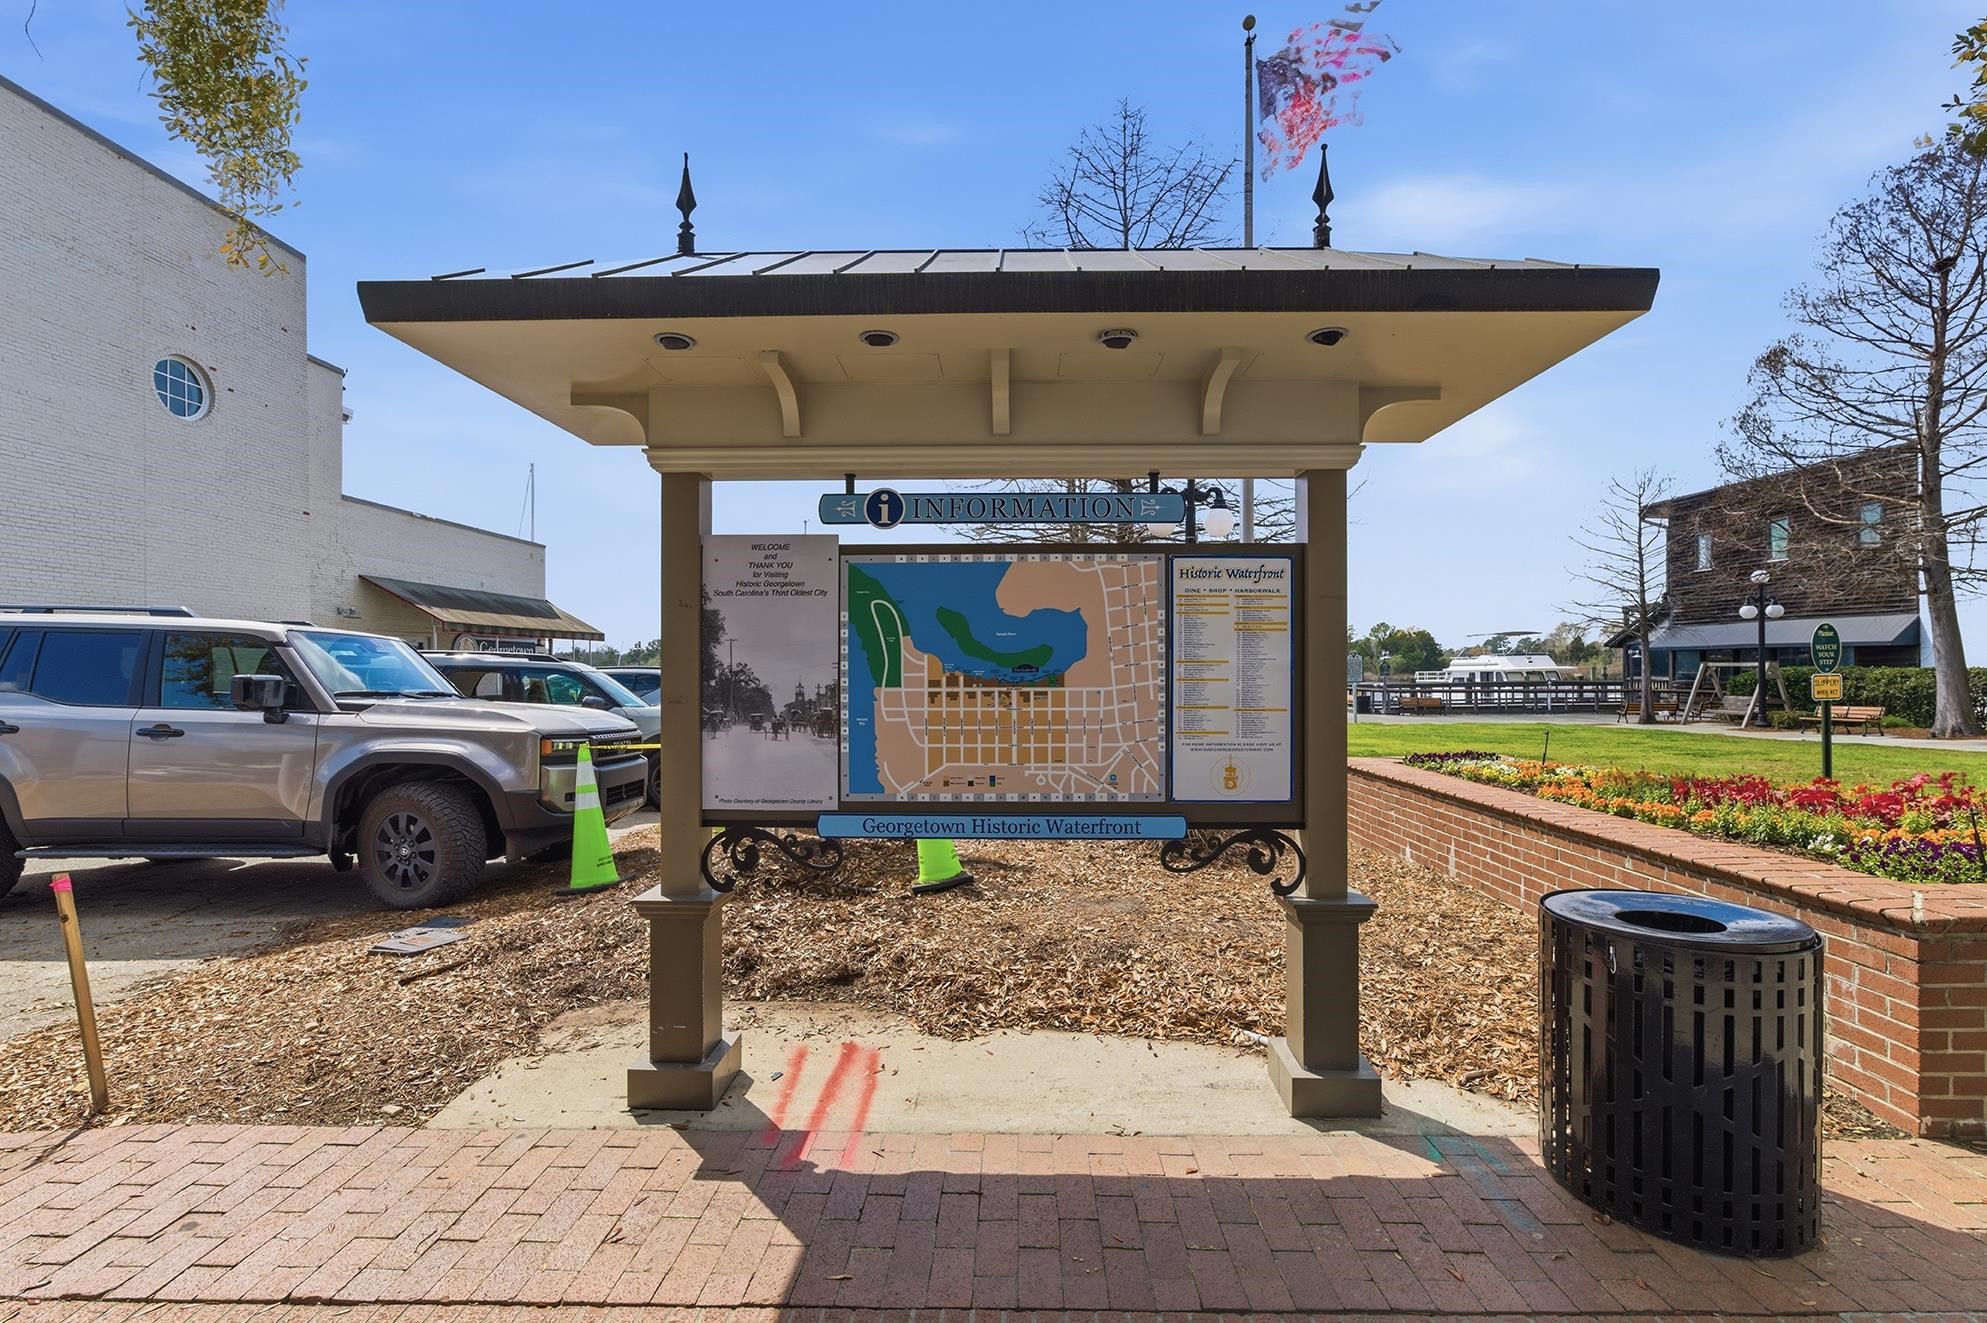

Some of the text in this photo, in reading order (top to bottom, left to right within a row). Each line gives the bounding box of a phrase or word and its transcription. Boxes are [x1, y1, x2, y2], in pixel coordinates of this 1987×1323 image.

[911, 496, 1136, 519] INFORMATION
[751, 543, 791, 551] WELCOME
[764, 571, 789, 579] Visiting
[1180, 564, 1285, 583] Historic Waterfront
[736, 580, 805, 589] Historic Georgetown
[735, 589, 769, 597] Carolina's
[771, 589, 789, 597] Third
[790, 589, 813, 597] Oldest
[814, 589, 828, 598] City
[862, 817, 1142, 837] Georgetown Historic Waterfront
